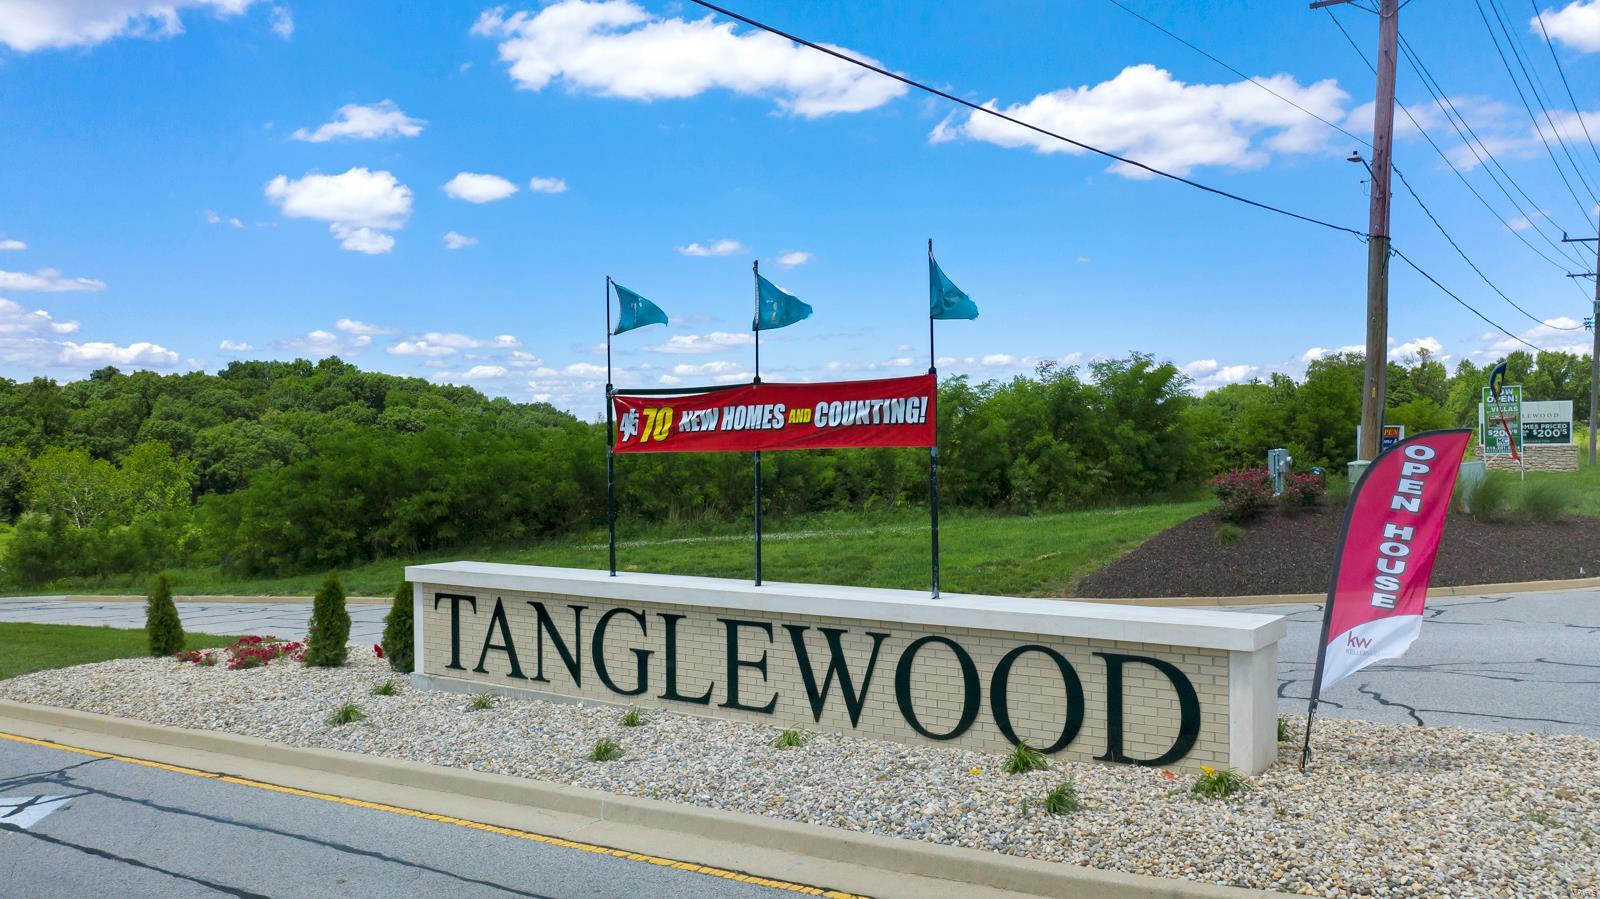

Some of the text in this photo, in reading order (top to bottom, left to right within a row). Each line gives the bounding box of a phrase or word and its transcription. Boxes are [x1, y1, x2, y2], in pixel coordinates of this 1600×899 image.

[640, 407, 673, 442] 70
[678, 406, 720, 432] NEW
[721, 403, 785, 430] HOMES
[788, 408, 811, 424] AND
[814, 396, 928, 428] COUNTING!
[1383, 428, 1398, 436] PEN
[1532, 429, 1568, 438] $200'S
[1371, 445, 1435, 609] OPEN HOUSE
[1347, 630, 1373, 648] kw
[433, 592, 1201, 767] TANGLEWOOD
